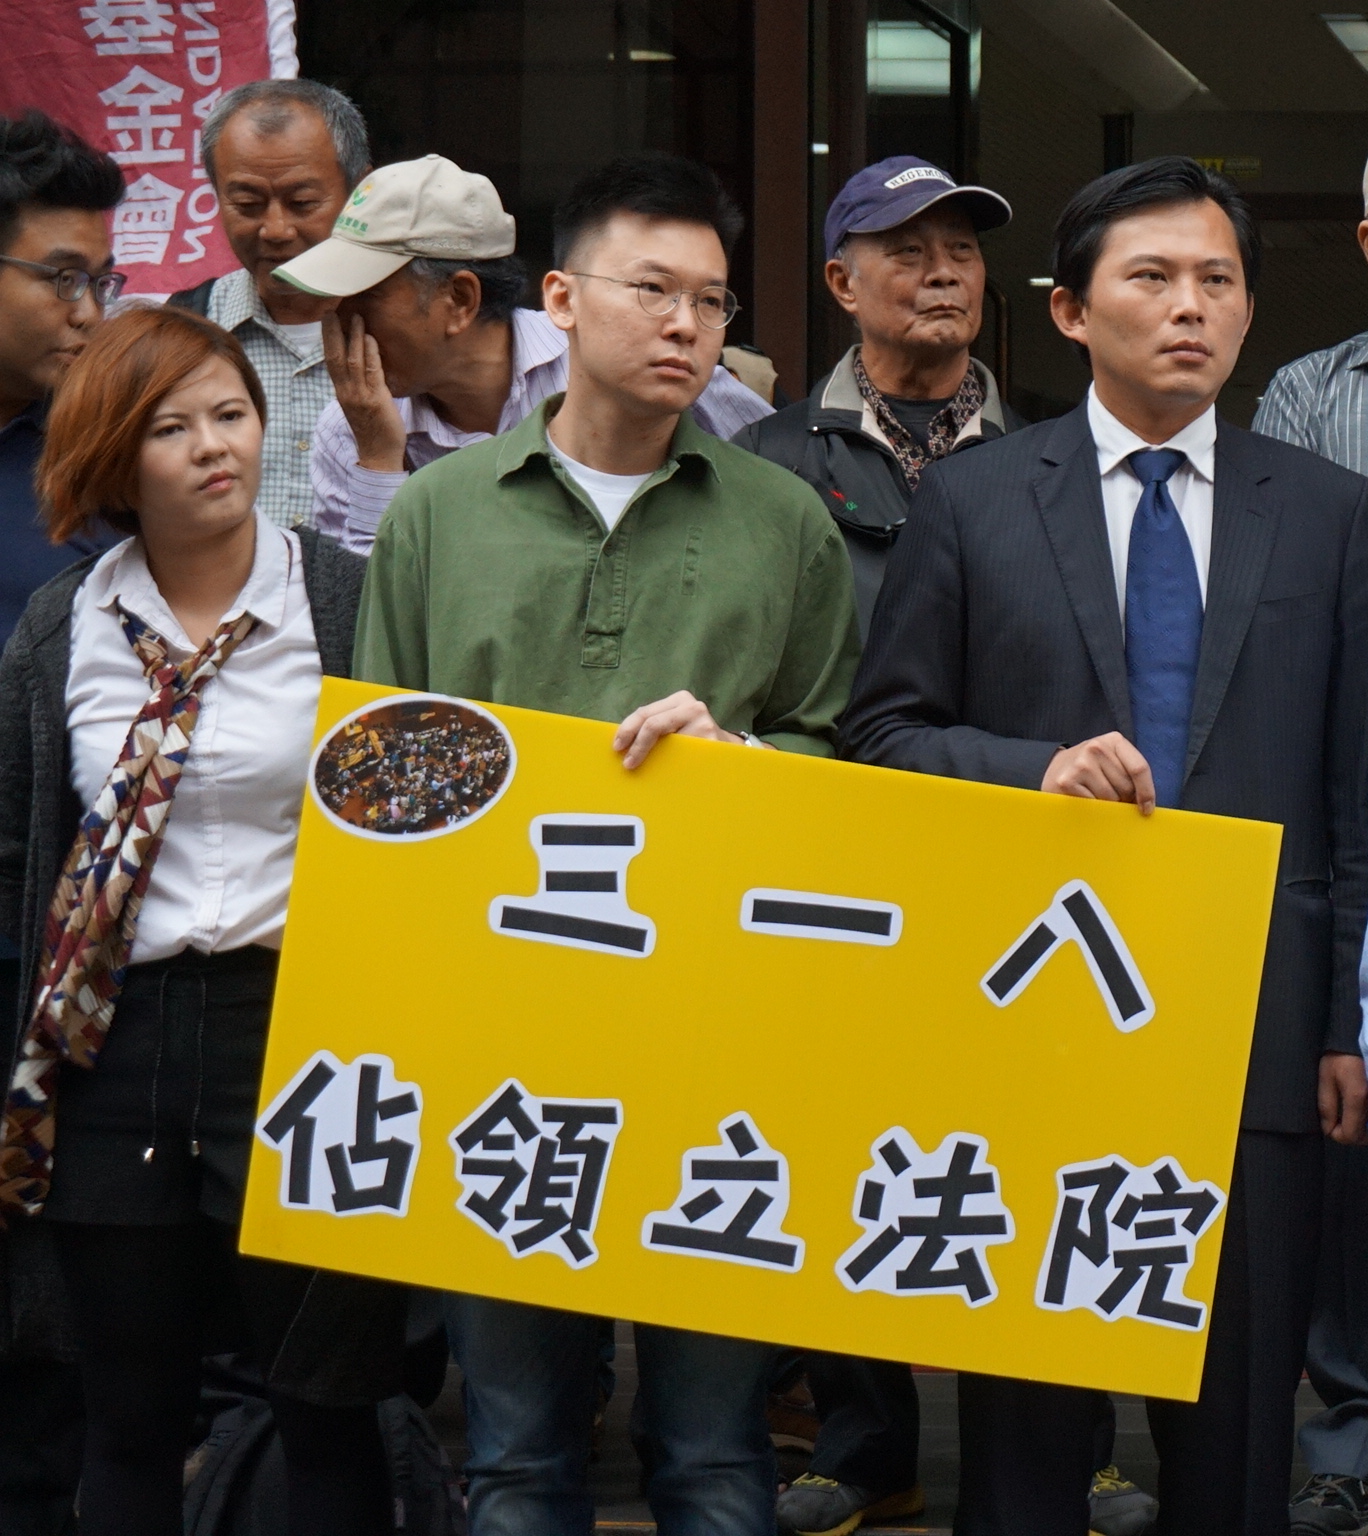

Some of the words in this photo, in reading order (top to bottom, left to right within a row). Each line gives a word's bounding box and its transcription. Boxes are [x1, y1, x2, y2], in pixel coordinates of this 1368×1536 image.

[890, 169, 953, 187] HEGEMO
[500, 822, 1147, 1022] 三一八
[262, 1057, 1221, 1328] 佔領立法院
